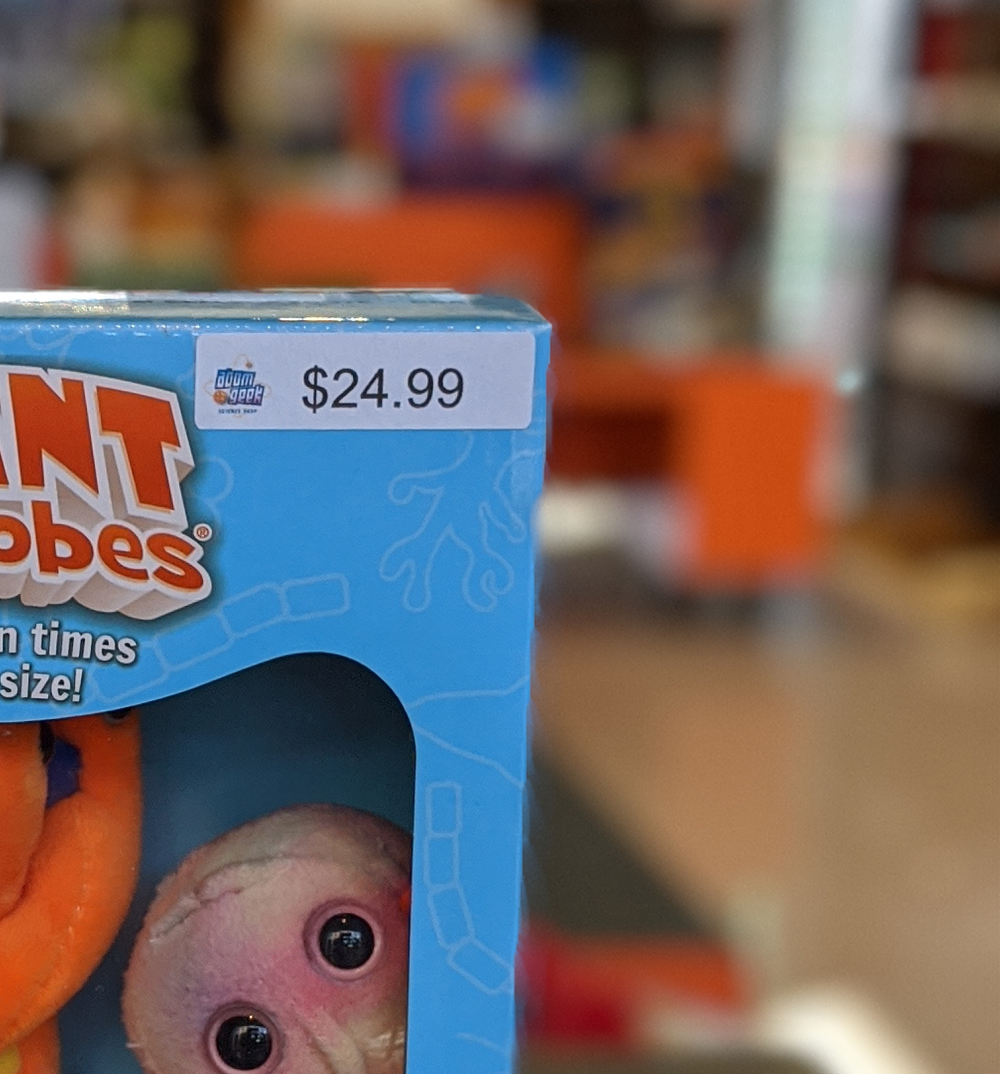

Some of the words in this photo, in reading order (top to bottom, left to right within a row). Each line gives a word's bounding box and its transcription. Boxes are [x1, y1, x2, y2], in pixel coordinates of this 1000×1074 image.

[228, 384, 264, 406] geek
[302, 365, 465, 414] $24.99
[31, 620, 138, 664] times
[0, 663, 83, 702] size!
